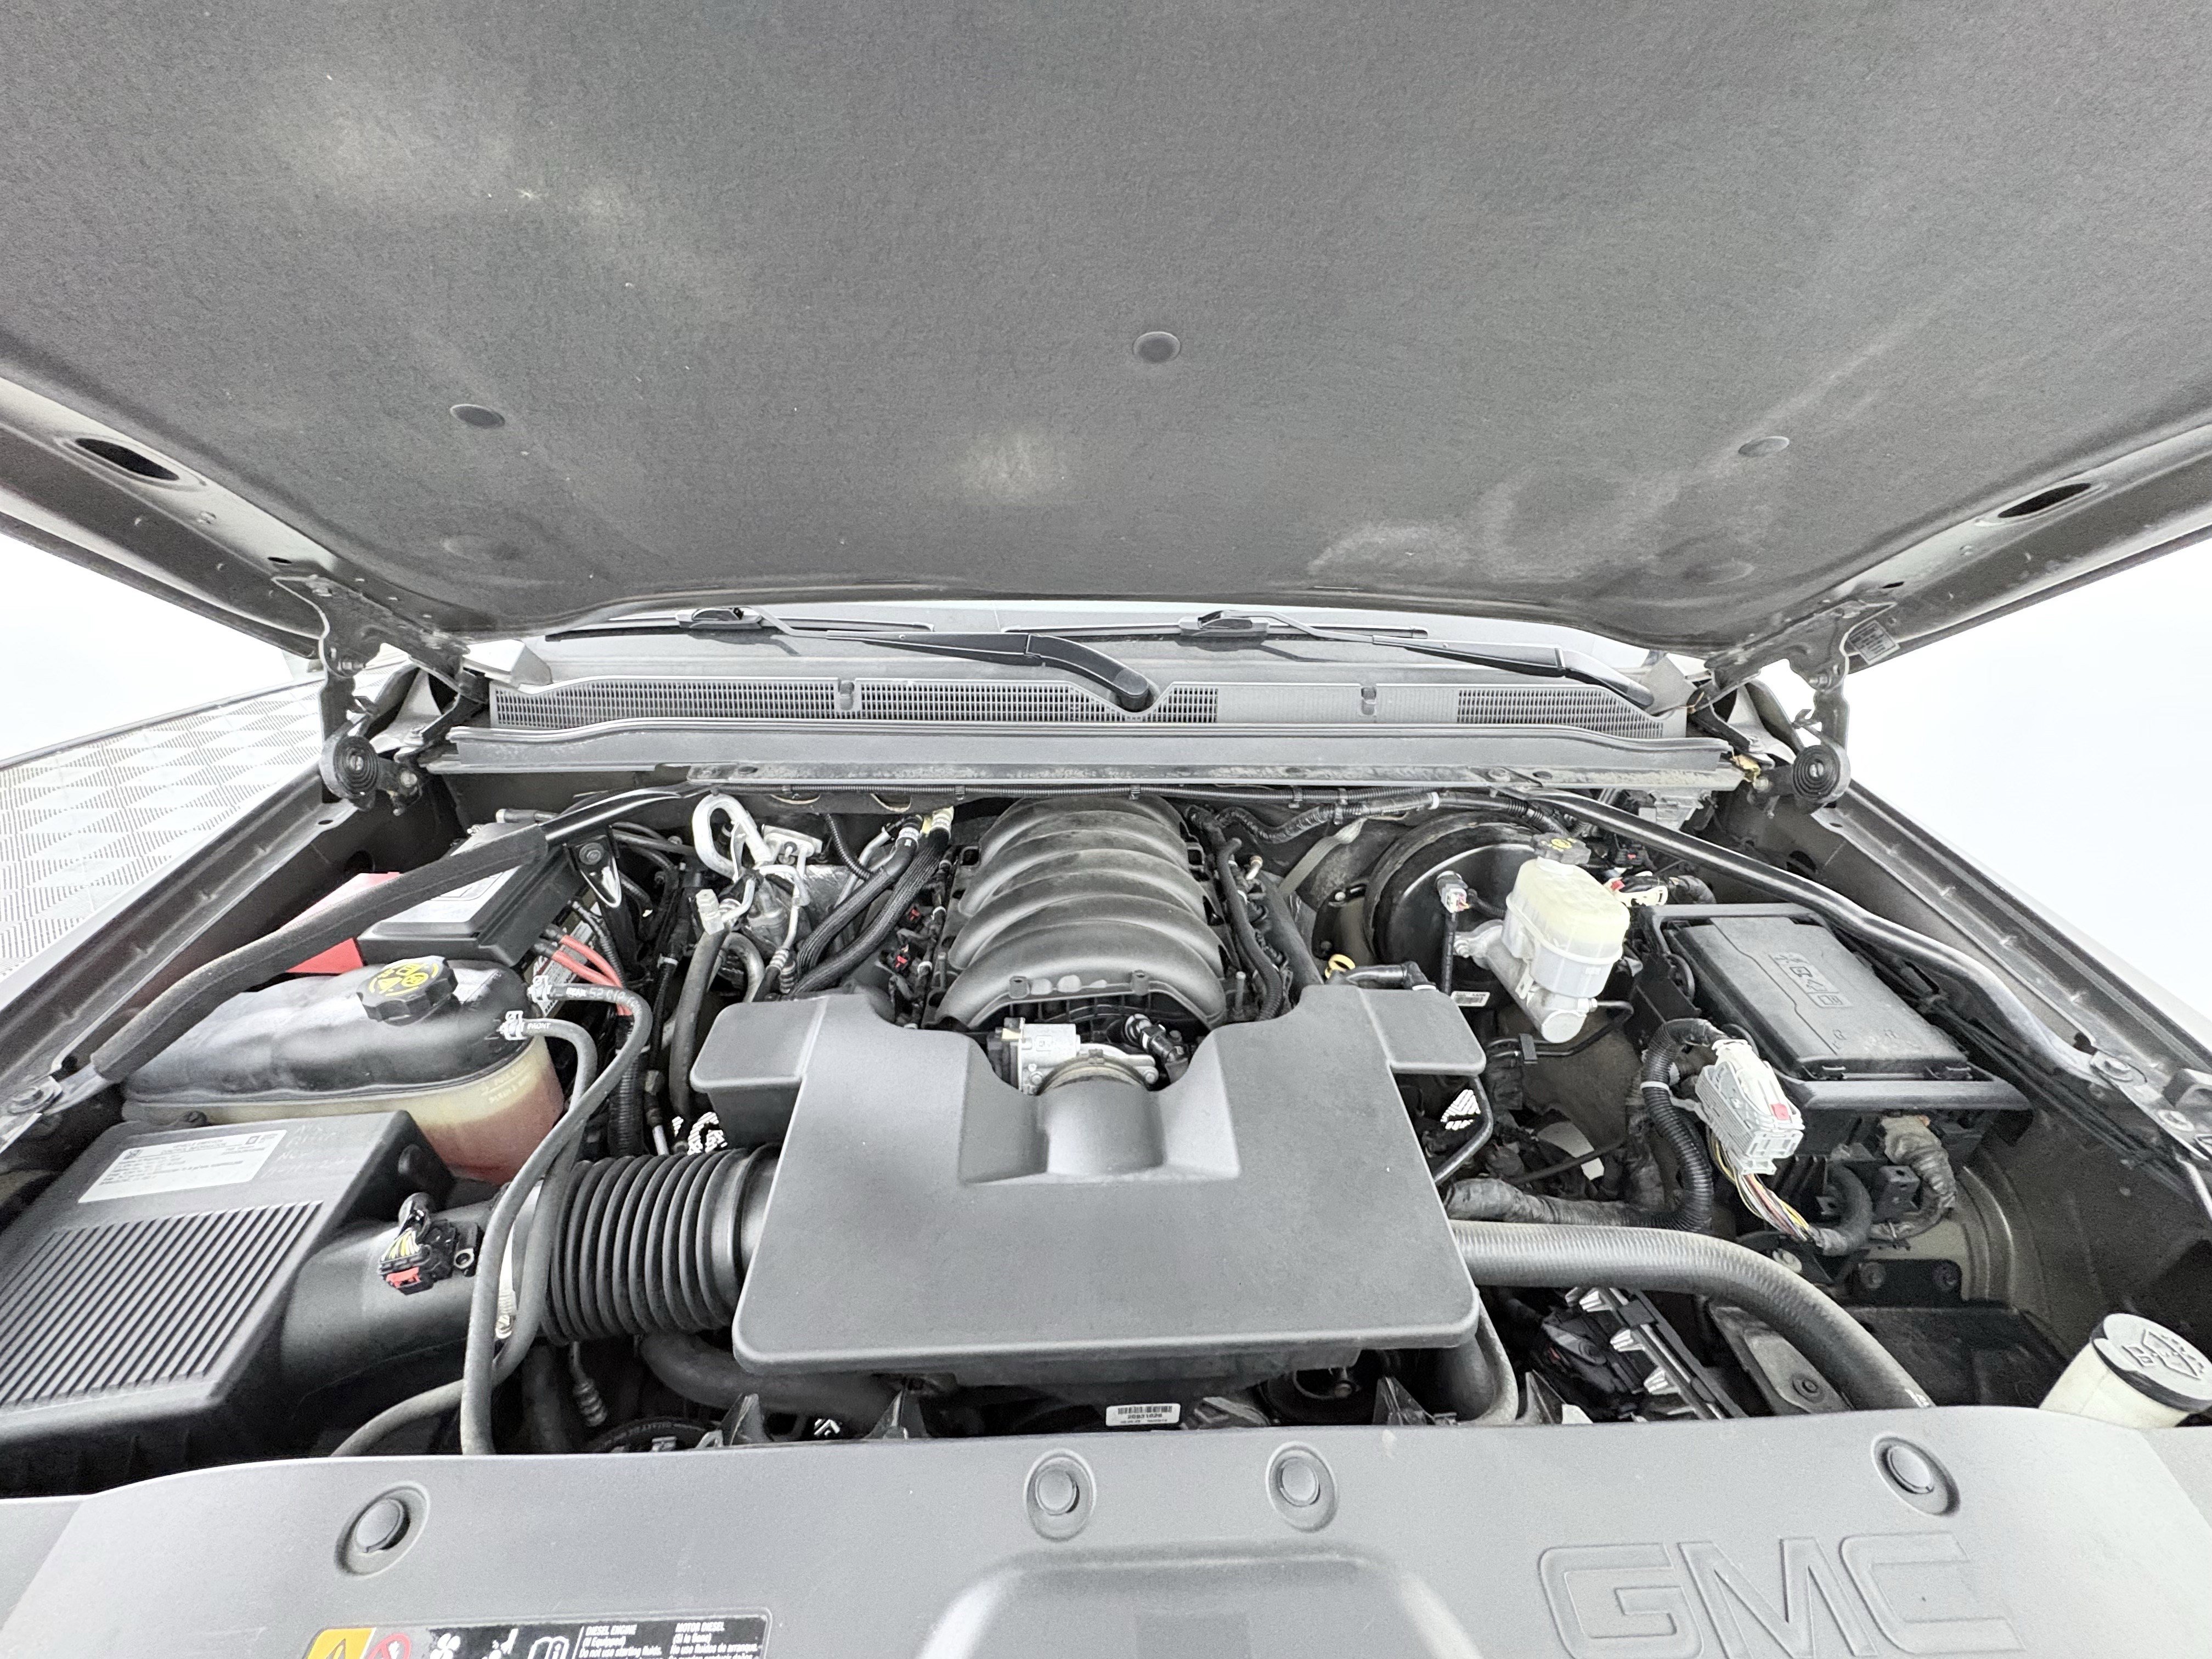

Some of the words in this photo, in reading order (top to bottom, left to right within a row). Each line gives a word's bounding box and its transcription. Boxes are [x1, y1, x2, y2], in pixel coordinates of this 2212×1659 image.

[1538, 1531, 2025, 1659] GMC
[585, 1626, 610, 1636] DIESEL
[610, 1624, 637, 1635] ENGINE
[675, 1622, 701, 1633] MOTOR
[701, 1621, 725, 1632] DIESEL
[591, 1635, 626, 1649] Equipped)
[579, 1647, 589, 1658] Do
[589, 1647, 602, 1658] not
[602, 1649, 615, 1657] use
[614, 1646, 642, 1658] starting
[670, 1644, 680, 1655] No
[680, 1645, 694, 1655] use
[694, 1644, 717, 1654] fluidos
[717, 1642, 727, 1652] de
